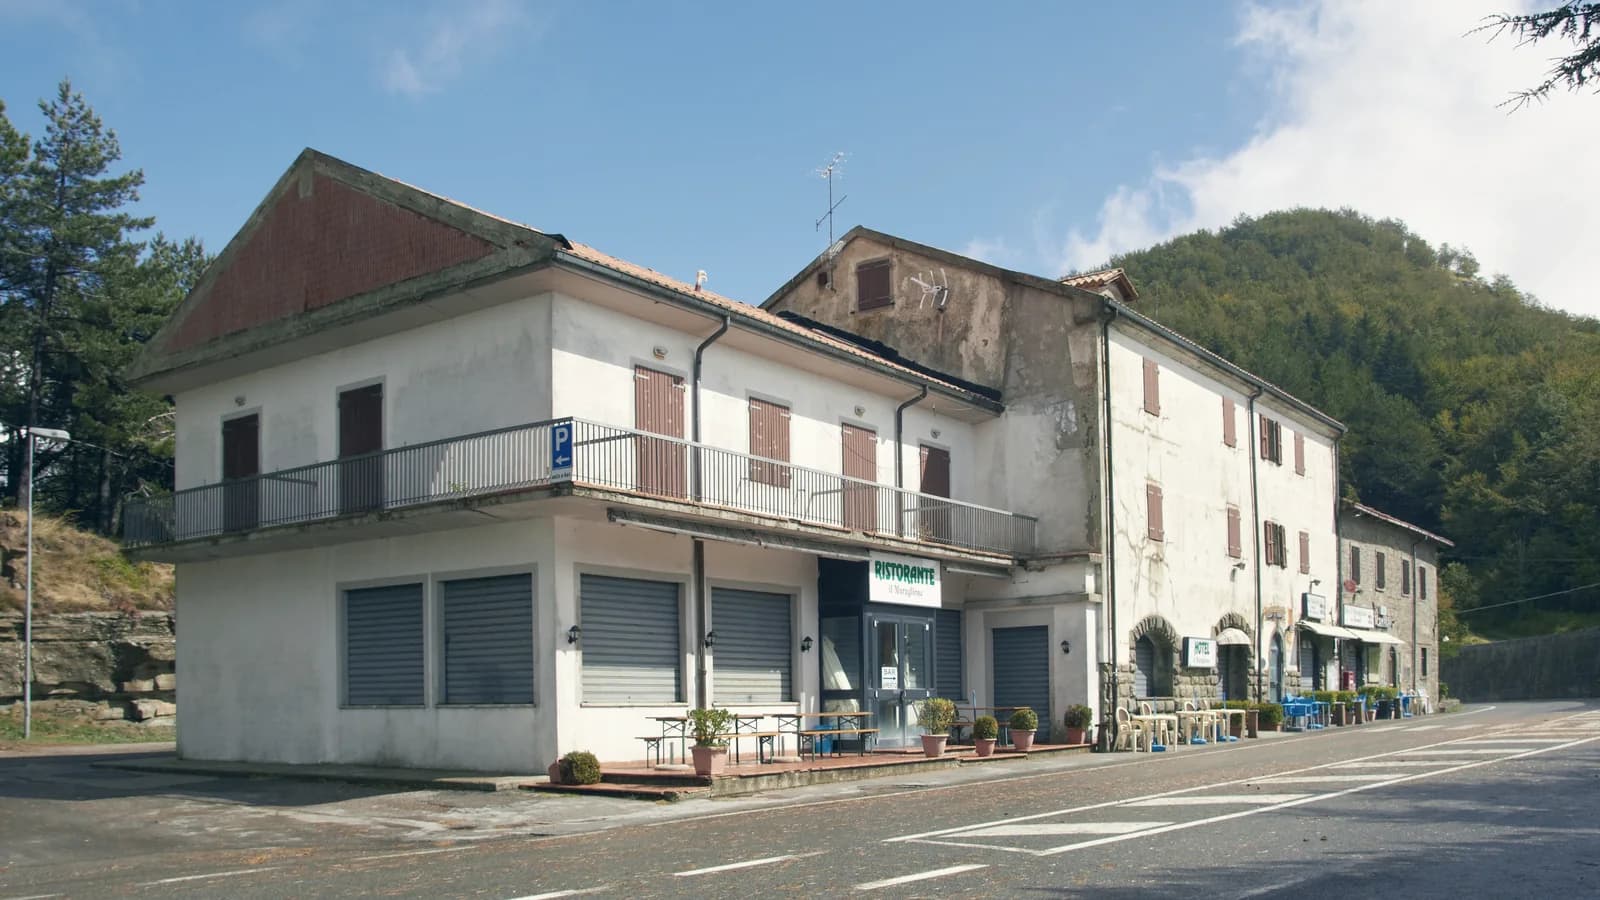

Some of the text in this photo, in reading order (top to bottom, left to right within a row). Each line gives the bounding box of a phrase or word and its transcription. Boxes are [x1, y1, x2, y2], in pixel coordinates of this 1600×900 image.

[555, 427, 569, 451] P
[874, 560, 935, 586] RISTORANTE
[1194, 640, 1210, 656] HOTEL
